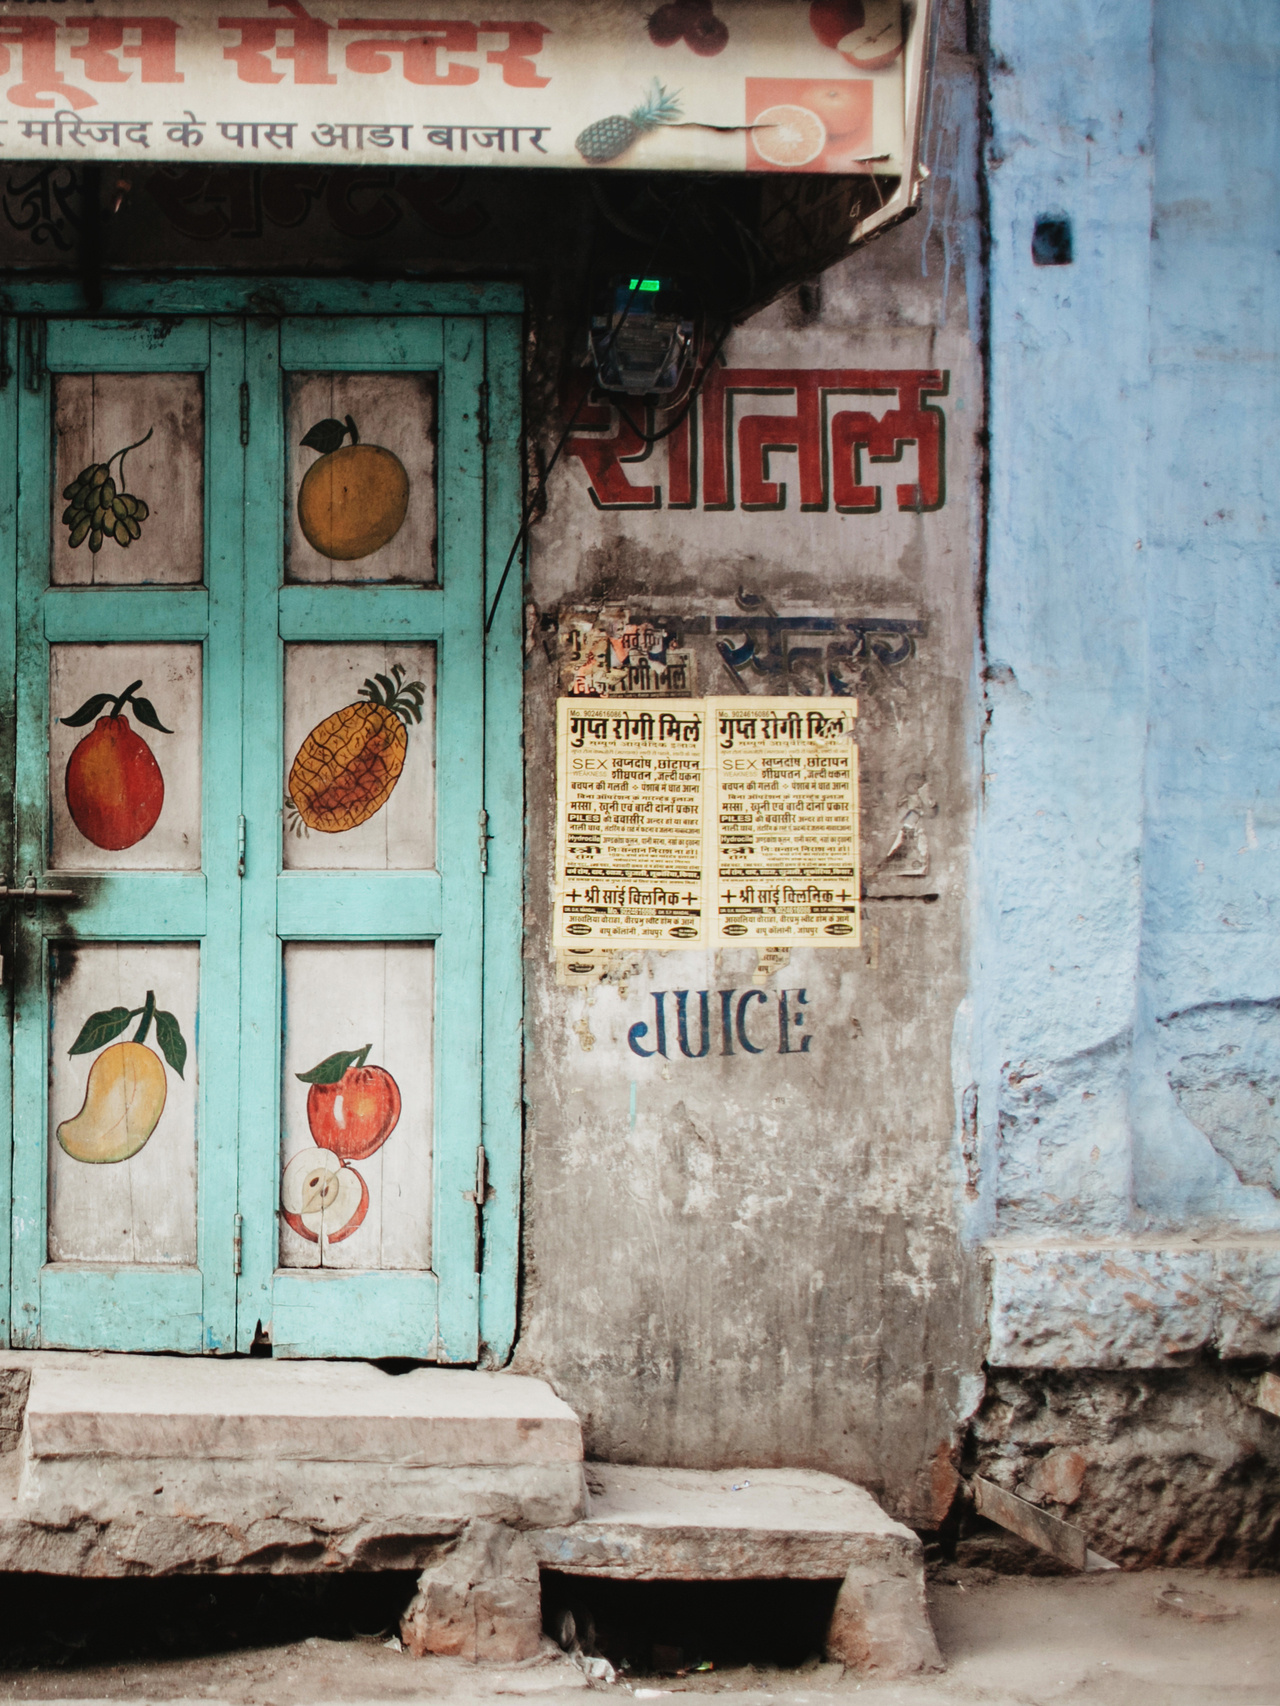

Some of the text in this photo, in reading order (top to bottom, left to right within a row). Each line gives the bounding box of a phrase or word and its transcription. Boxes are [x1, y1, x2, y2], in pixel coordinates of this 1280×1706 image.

[218, 0, 553, 89] सेन्टर
[17, 110, 153, 149] मस्जिद
[163, 111, 207, 148] के
[217, 120, 296, 149] पास
[310, 123, 413, 152] आडा
[423, 125, 552, 155] बाजार
[570, 711, 702, 747] गुप्त रोगी मिले
[719, 718, 757, 748] गुप्त
[760, 711, 803, 739] रोगी
[572, 758, 608, 770] SEX
[722, 759, 758, 770] SEX
[596, 780, 606, 790] की
[746, 780, 756, 790] की
[569, 814, 600, 822] PILES
[584, 885, 600, 904] श्री
[740, 885, 755, 903] श्री
[627, 988, 814, 1060] JUICE
